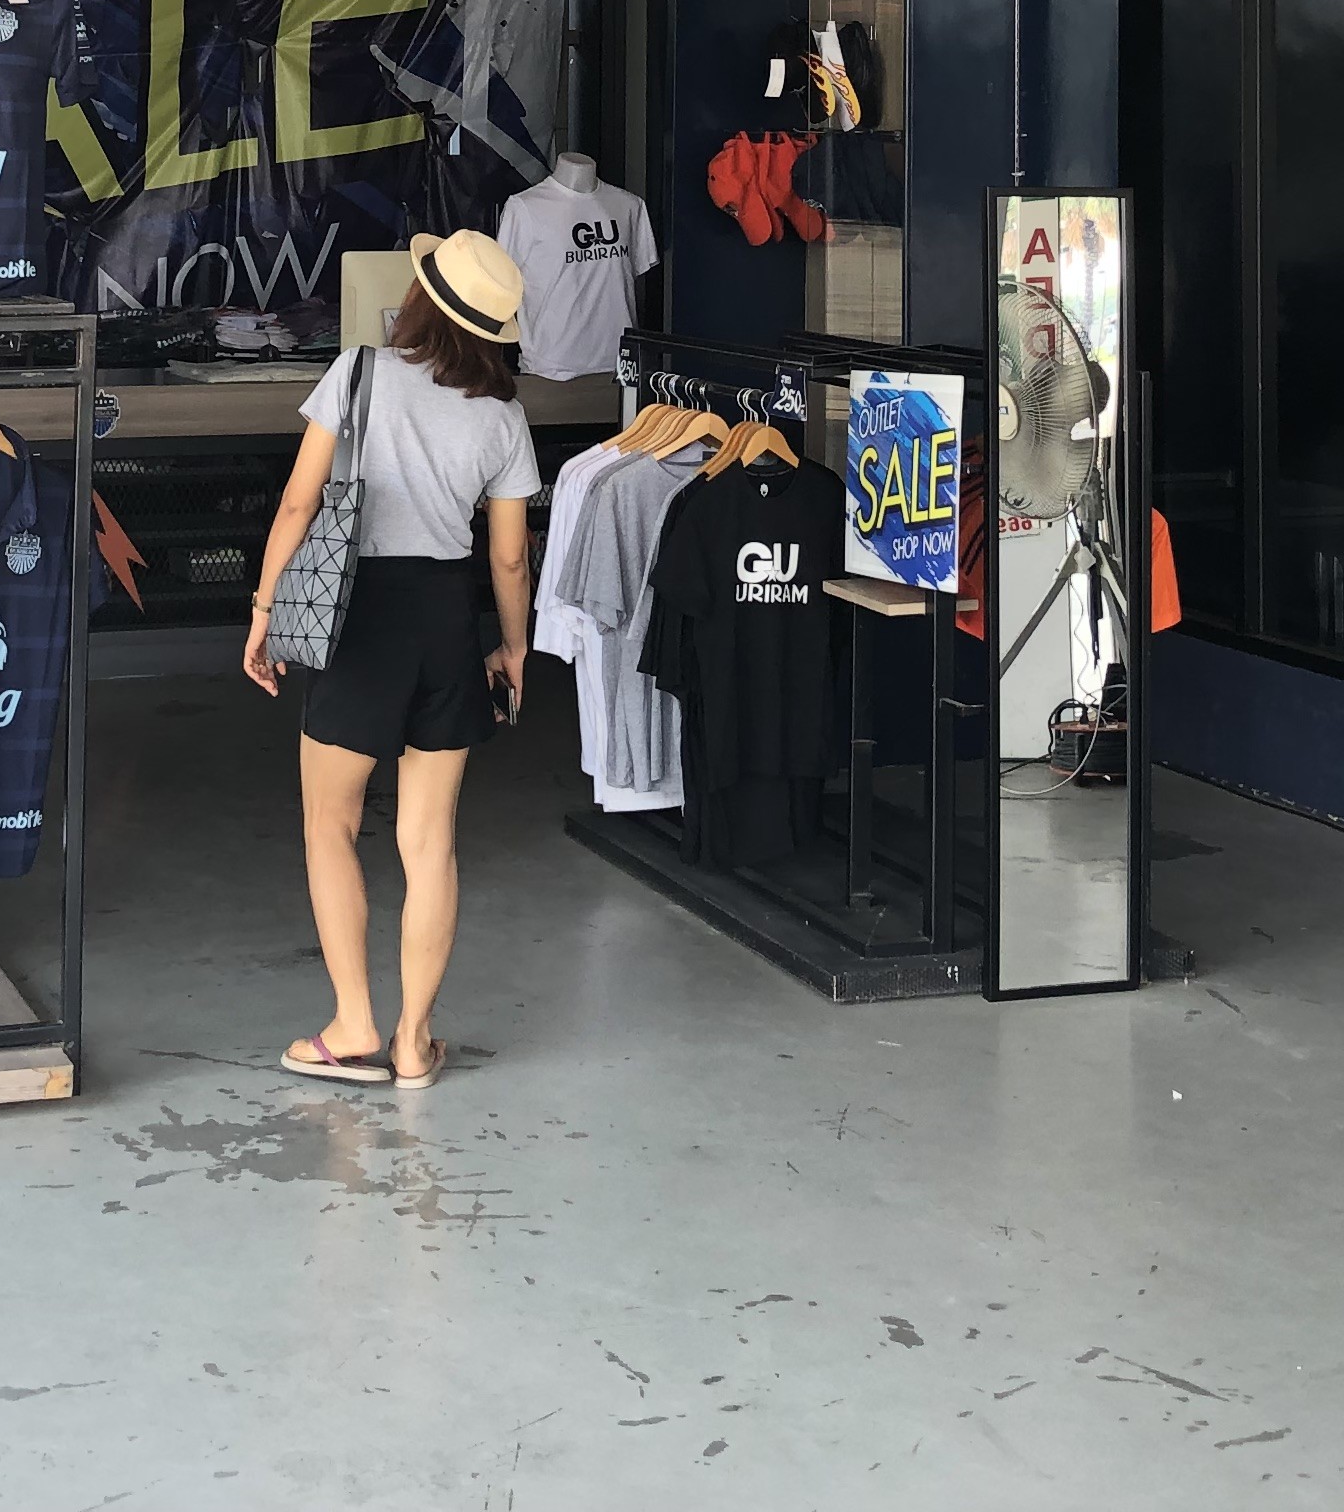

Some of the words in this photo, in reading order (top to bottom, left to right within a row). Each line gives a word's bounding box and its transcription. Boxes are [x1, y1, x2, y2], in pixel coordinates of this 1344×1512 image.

[572, 219, 620, 250] GU
[97, 222, 340, 312] NOW
[565, 245, 629, 264] BURIRAM
[858, 396, 905, 439] OUTLET
[857, 430, 955, 534] SALE
[736, 541, 800, 584] GU
[892, 536, 920, 562] SHOP
[922, 530, 955, 557] NOW
[736, 583, 809, 604] URIRAM
